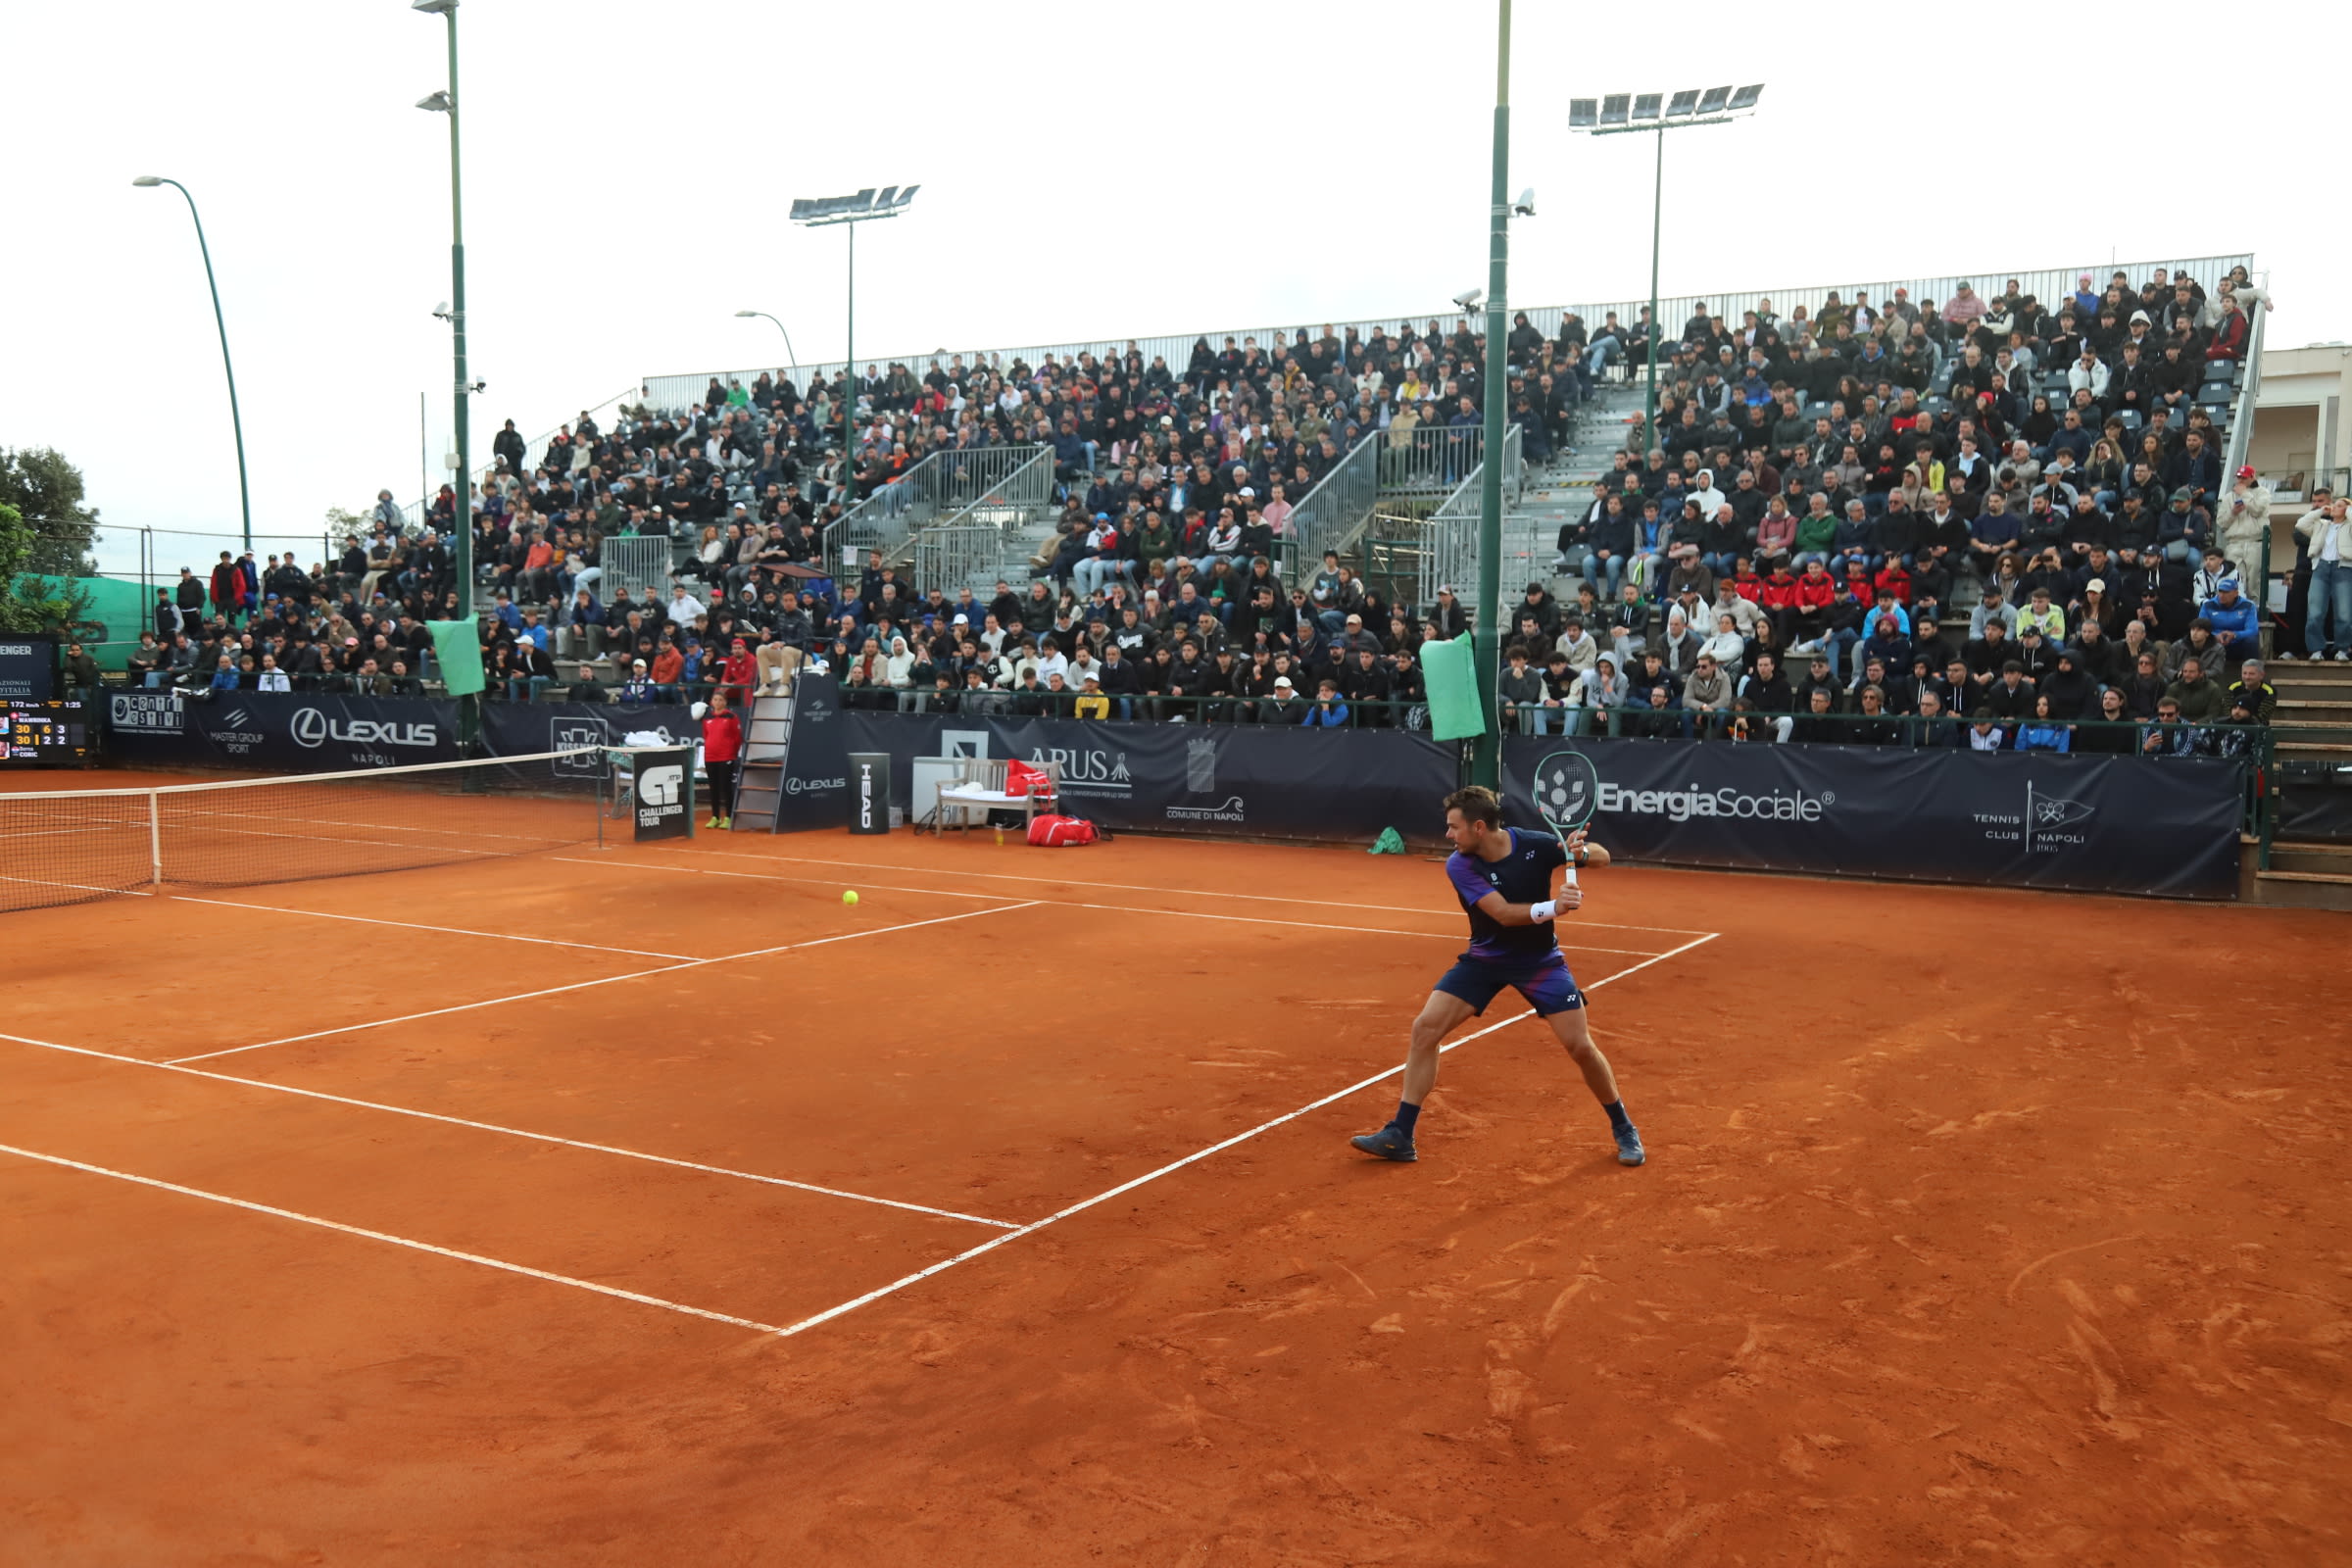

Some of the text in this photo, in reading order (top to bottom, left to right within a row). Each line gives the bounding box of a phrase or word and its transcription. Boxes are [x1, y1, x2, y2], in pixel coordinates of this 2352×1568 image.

[130, 712, 179, 726] estivi
[16, 724, 66, 734] 30 6 3
[329, 718, 437, 747] LEXUS
[16, 736, 66, 745] 30 2 2
[238, 732, 265, 744] GROUP
[352, 753, 396, 766] NAPOLI
[803, 778, 846, 791] LEXUS
[860, 763, 871, 829] HEAD
[639, 805, 683, 817] CHALLENGER
[1166, 810, 1244, 821] COMUNE DI NAPOLI
[639, 816, 660, 827] TOUR
[1973, 813, 2020, 823] TENNIS
[1985, 830, 2019, 840] CLUB
[2037, 833, 2084, 844] NAPOLI
